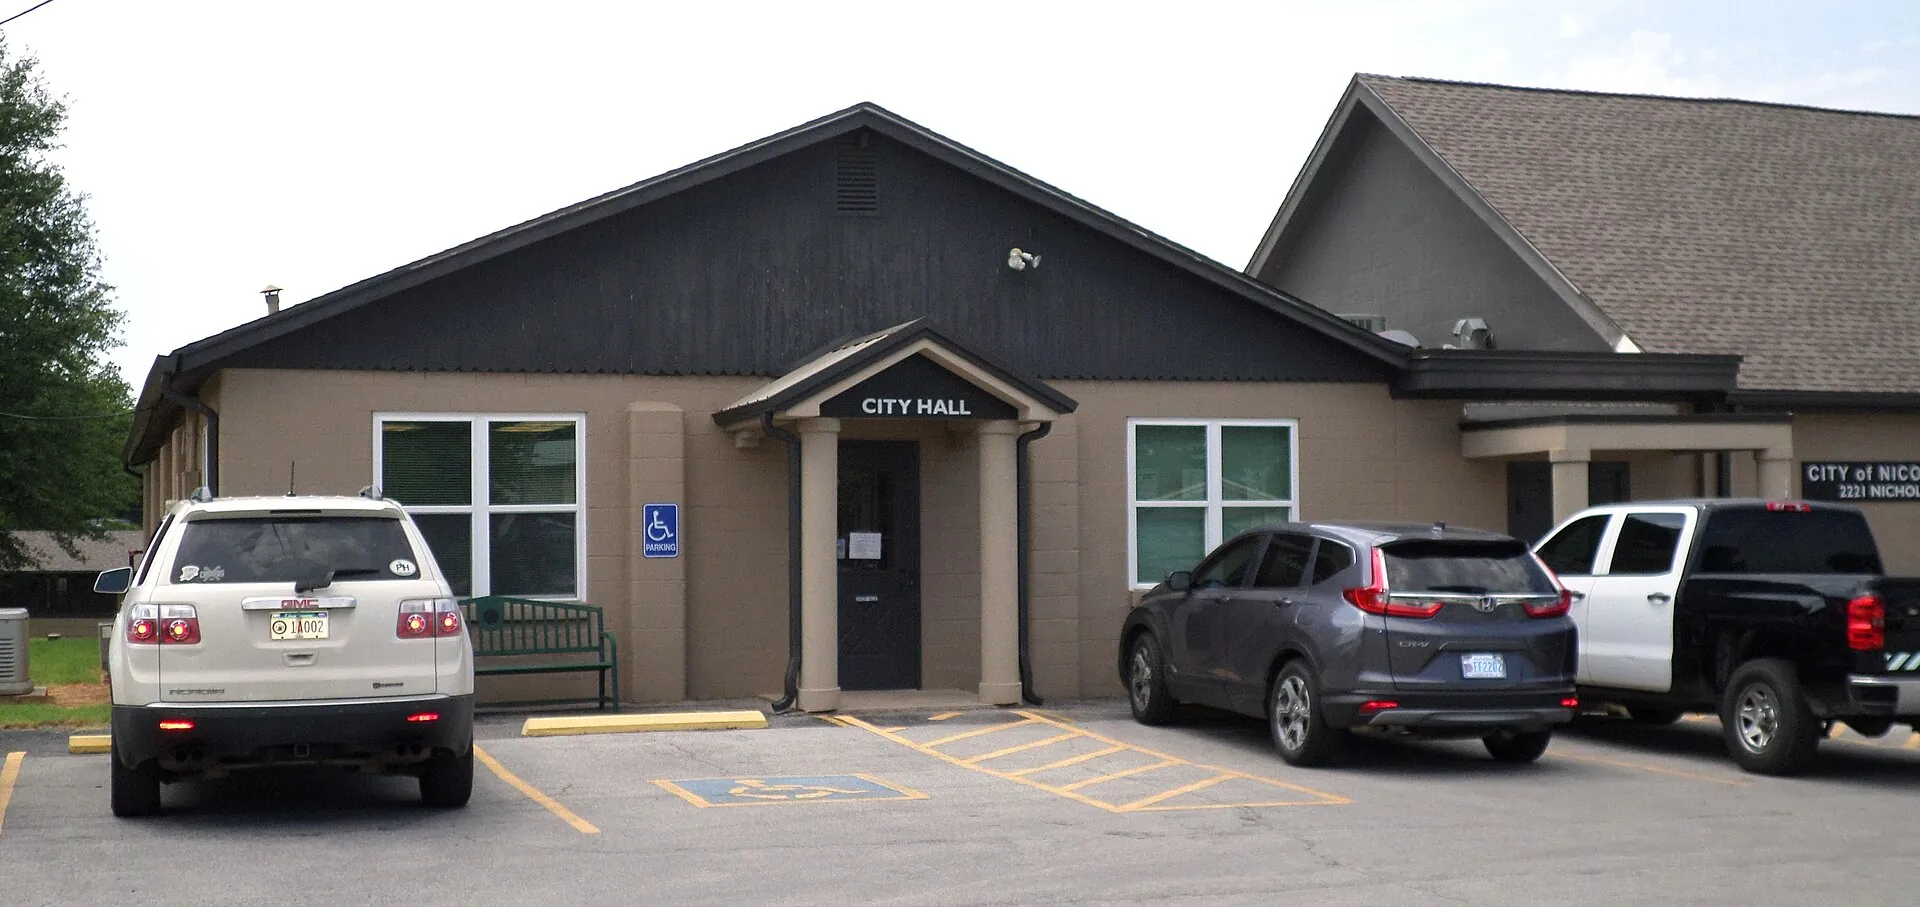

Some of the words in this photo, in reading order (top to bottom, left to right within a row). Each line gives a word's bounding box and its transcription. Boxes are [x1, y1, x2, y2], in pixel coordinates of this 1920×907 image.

[861, 398, 912, 415] CITY
[917, 399, 972, 415] HALL
[1808, 465, 1849, 481] CITY
[1856, 464, 1872, 481] of
[1840, 484, 1866, 498] 2221
[645, 543, 676, 551] PARKING
[281, 599, 319, 609] GMC
[291, 620, 324, 634] 1A002
